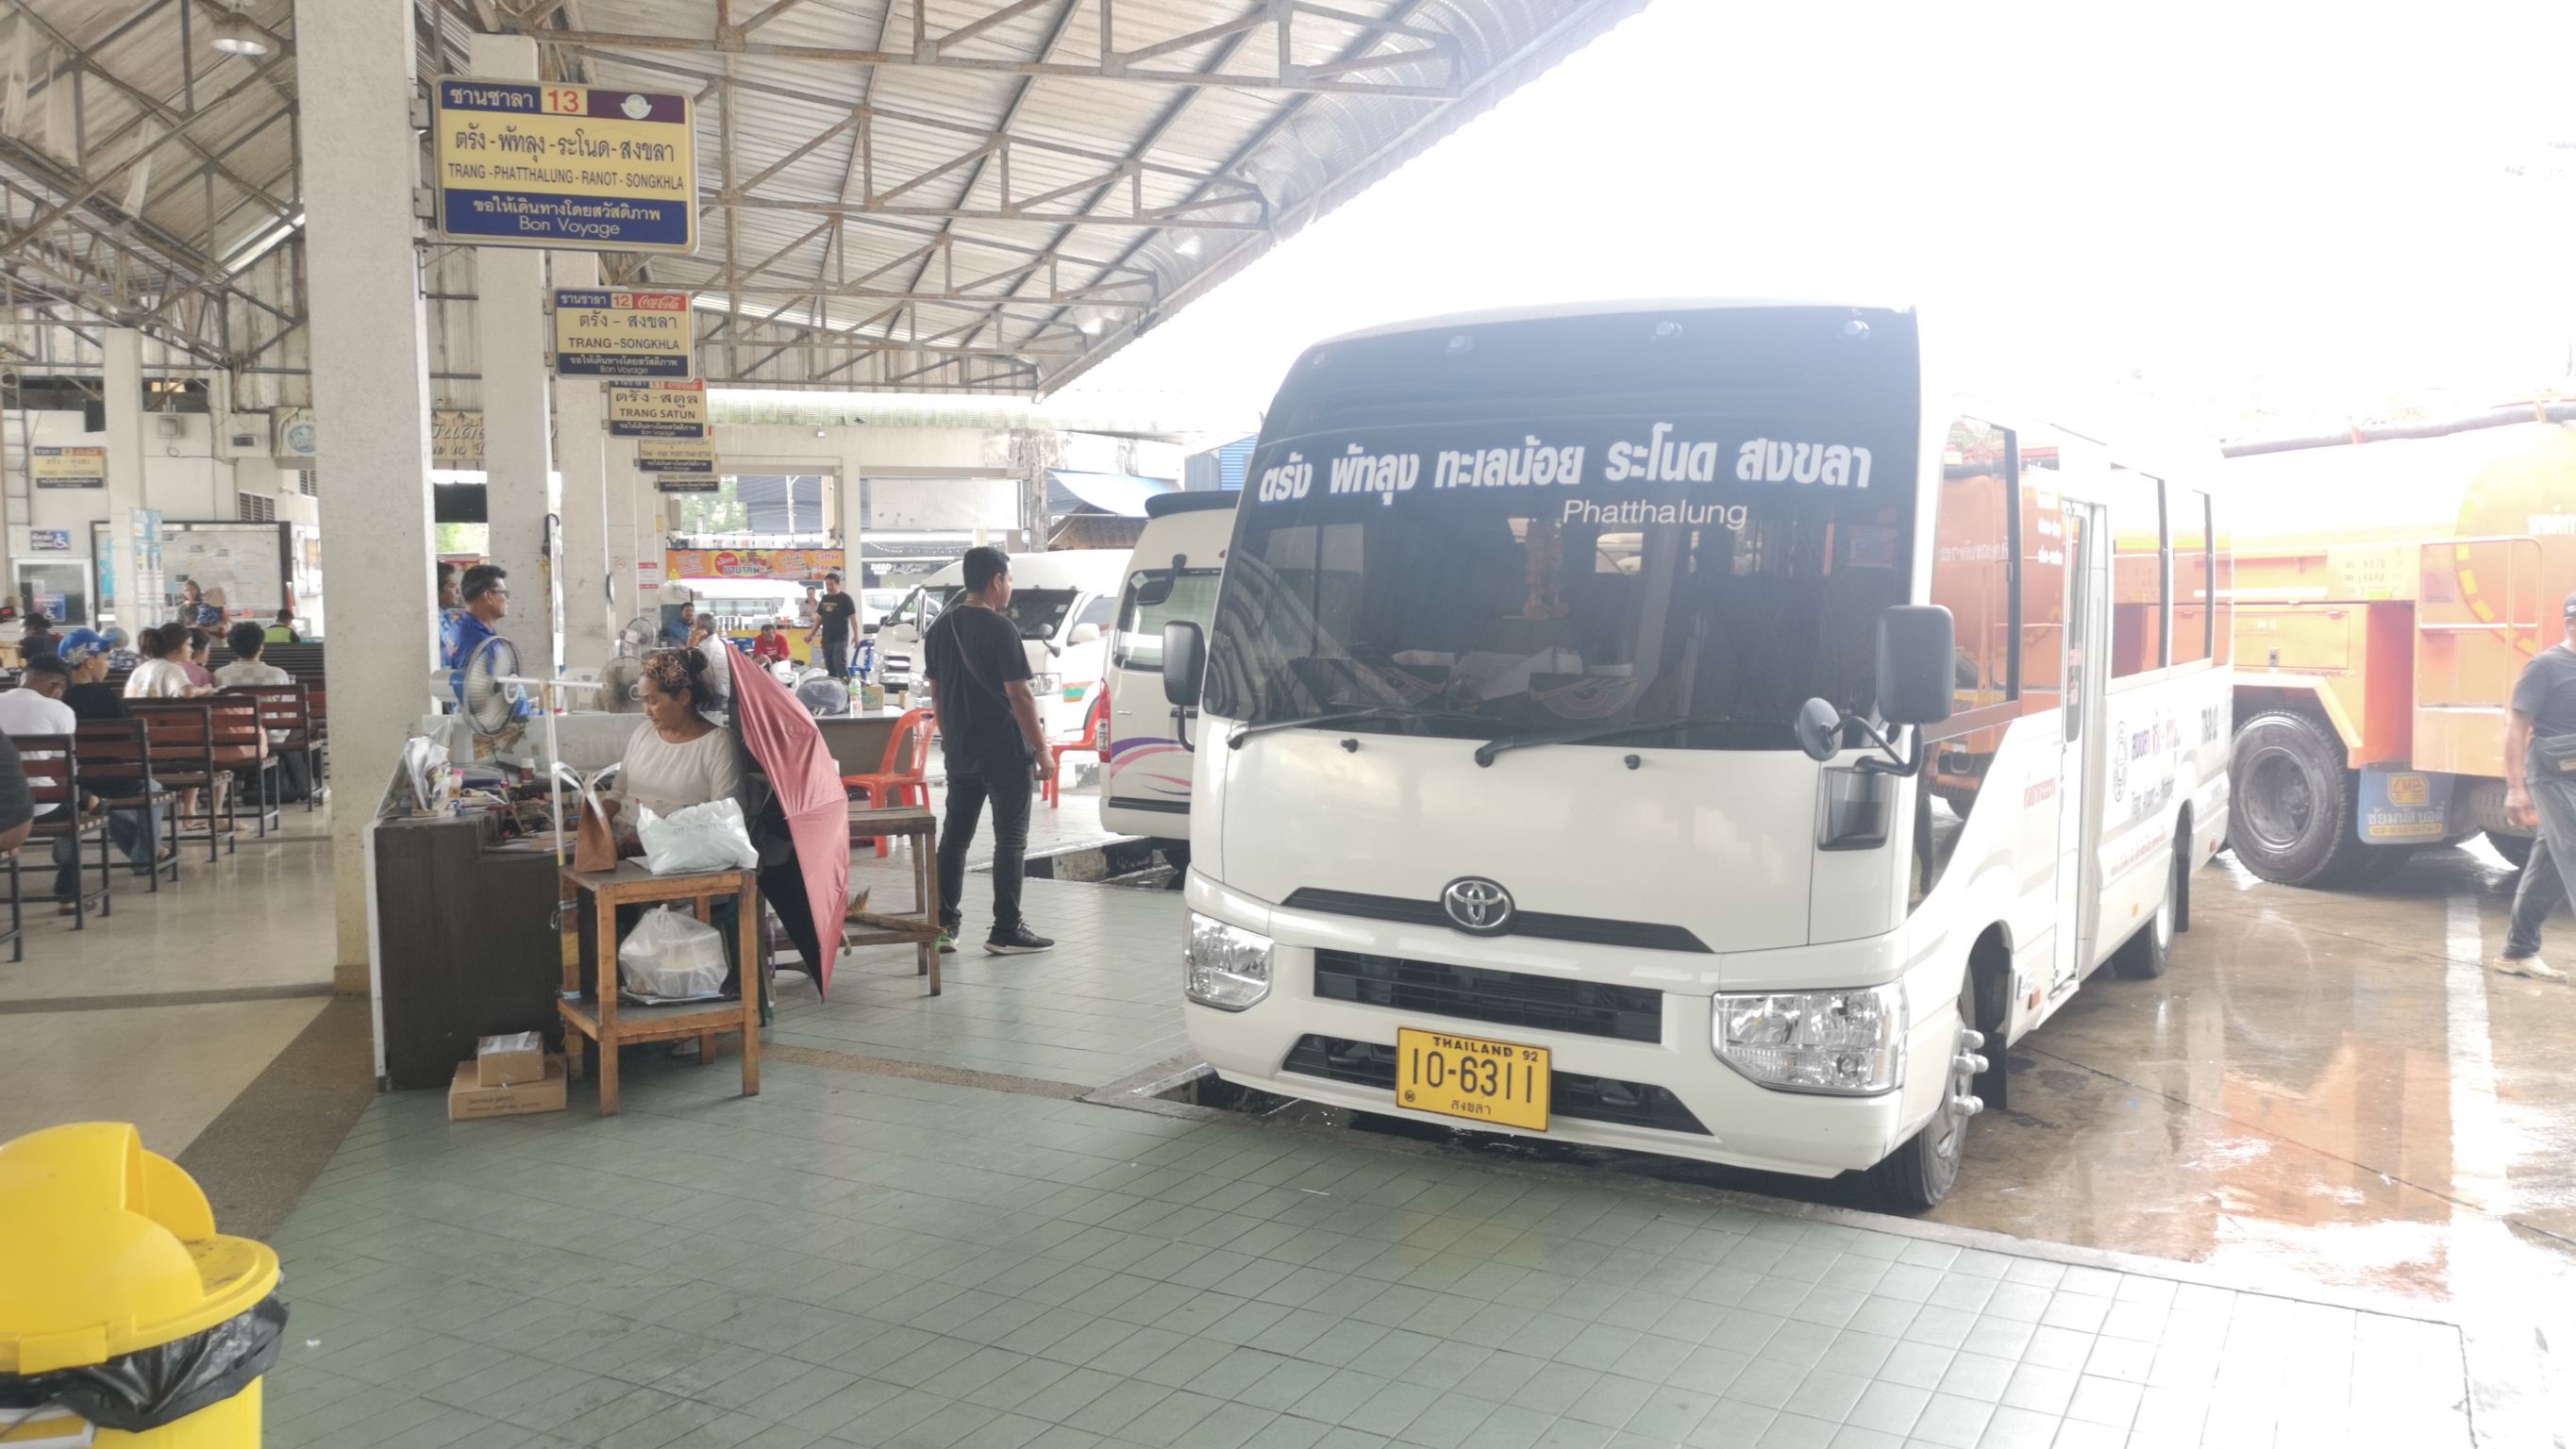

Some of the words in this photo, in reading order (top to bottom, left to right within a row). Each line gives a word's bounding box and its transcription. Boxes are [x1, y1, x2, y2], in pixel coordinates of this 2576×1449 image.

[450, 88, 534, 109] ชานชาลา
[547, 90, 579, 112] 13
[456, 123, 486, 151] ตรัง
[498, 125, 545, 162] พัทลุง
[558, 128, 611, 158] ระโนด
[620, 139, 674, 162] สงขลา
[448, 162, 486, 179] TRANG
[493, 166, 574, 184] PHATTHALUNG
[581, 170, 619, 186] RANOT
[626, 173, 684, 190] SONGKHLA
[473, 195, 661, 221] ขอให้เดินทางโดยสวัสดิภาพ
[519, 216, 551, 231] Bon
[558, 218, 621, 238] Voyage
[560, 294, 607, 305] ชานชาลา
[613, 295, 630, 307] 12
[579, 309, 609, 327] ตรัง
[627, 315, 677, 329] สงขลา
[616, 389, 649, 402] ตรัง
[619, 408, 658, 418] TRANG
[660, 409, 695, 419] SATUN
[1259, 451, 1313, 502] ตรัง
[1330, 442, 1419, 506] พัทลุง
[1433, 435, 1585, 488] ทะเลน้อย
[1605, 422, 1718, 482] ระโนด
[1736, 437, 1873, 488] สงขลา
[1563, 498, 1748, 530] Phatthalung
[1432, 1037, 1514, 1058] THAILAND
[1522, 1049, 1539, 1062] 92
[1413, 1047, 1532, 1104] 10-6311
[1451, 1099, 1492, 1115] สงขลา
